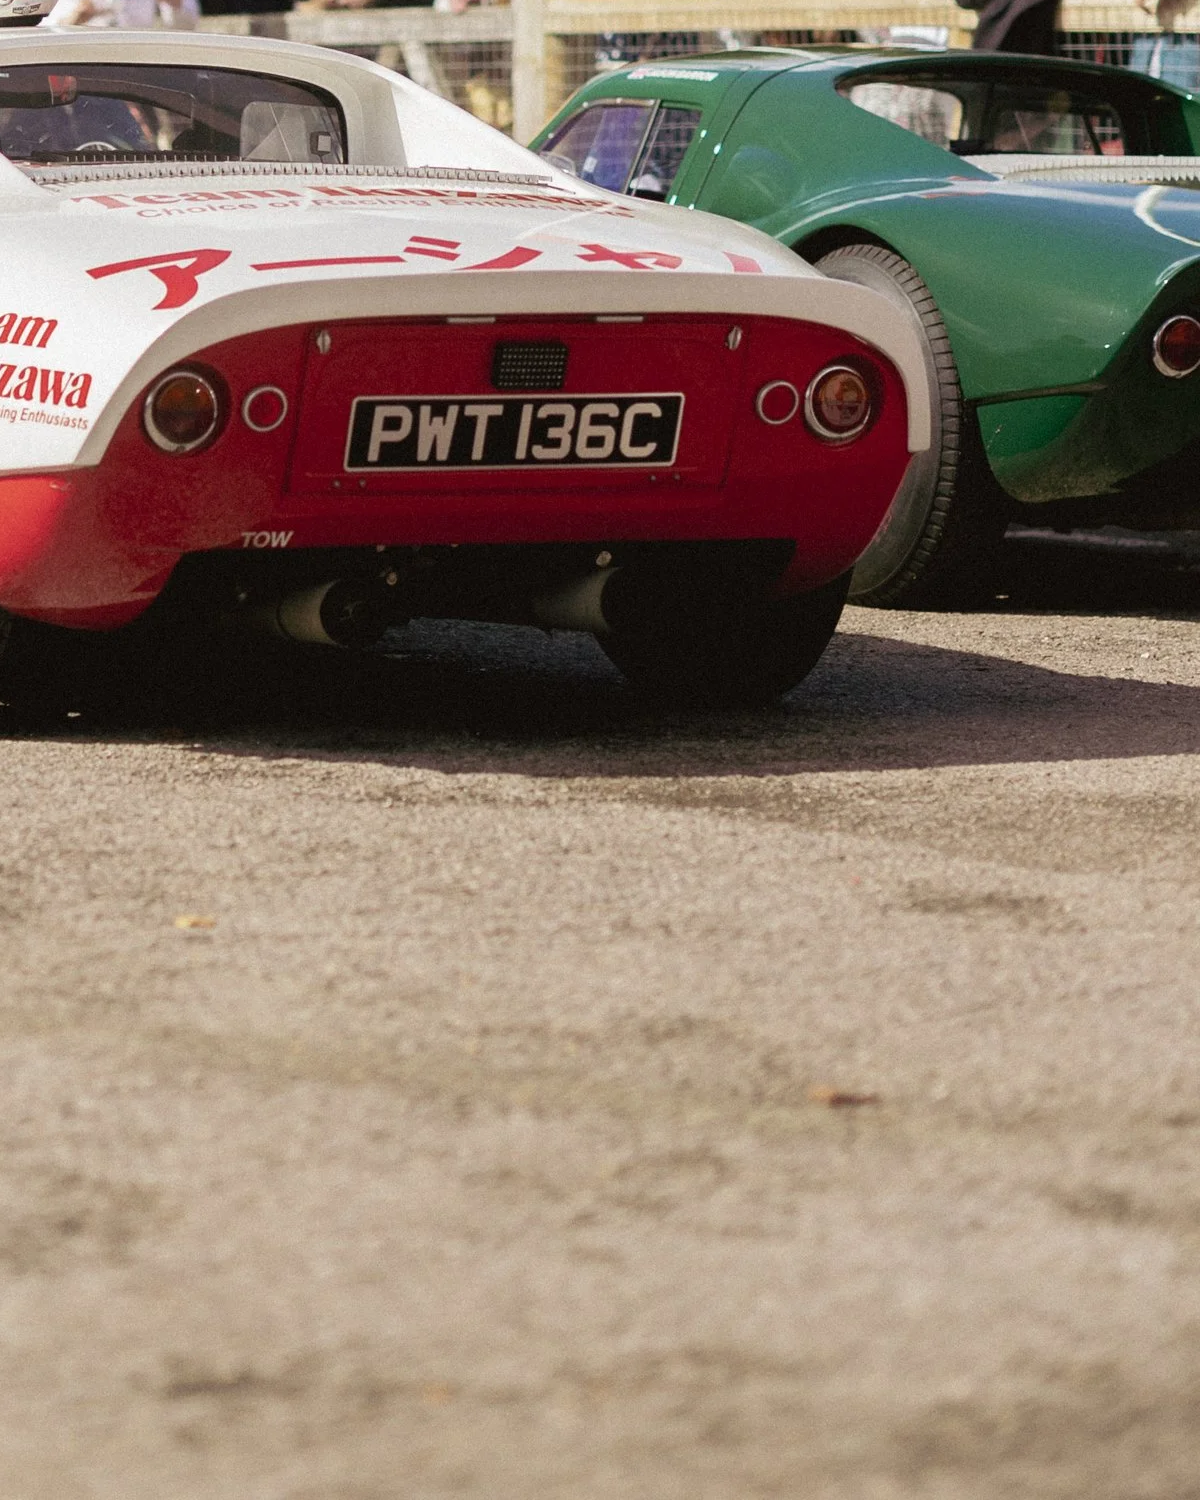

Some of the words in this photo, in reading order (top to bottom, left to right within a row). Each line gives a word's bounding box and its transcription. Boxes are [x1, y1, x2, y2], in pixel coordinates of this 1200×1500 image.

[69, 188, 301, 210] Team
[136, 202, 257, 218] Choice
[268, 199, 302, 209] of
[19, 408, 90, 430] Enthusiasts
[367, 404, 504, 462] PWT
[514, 403, 662, 460] 136C
[241, 530, 295, 548] TOW
